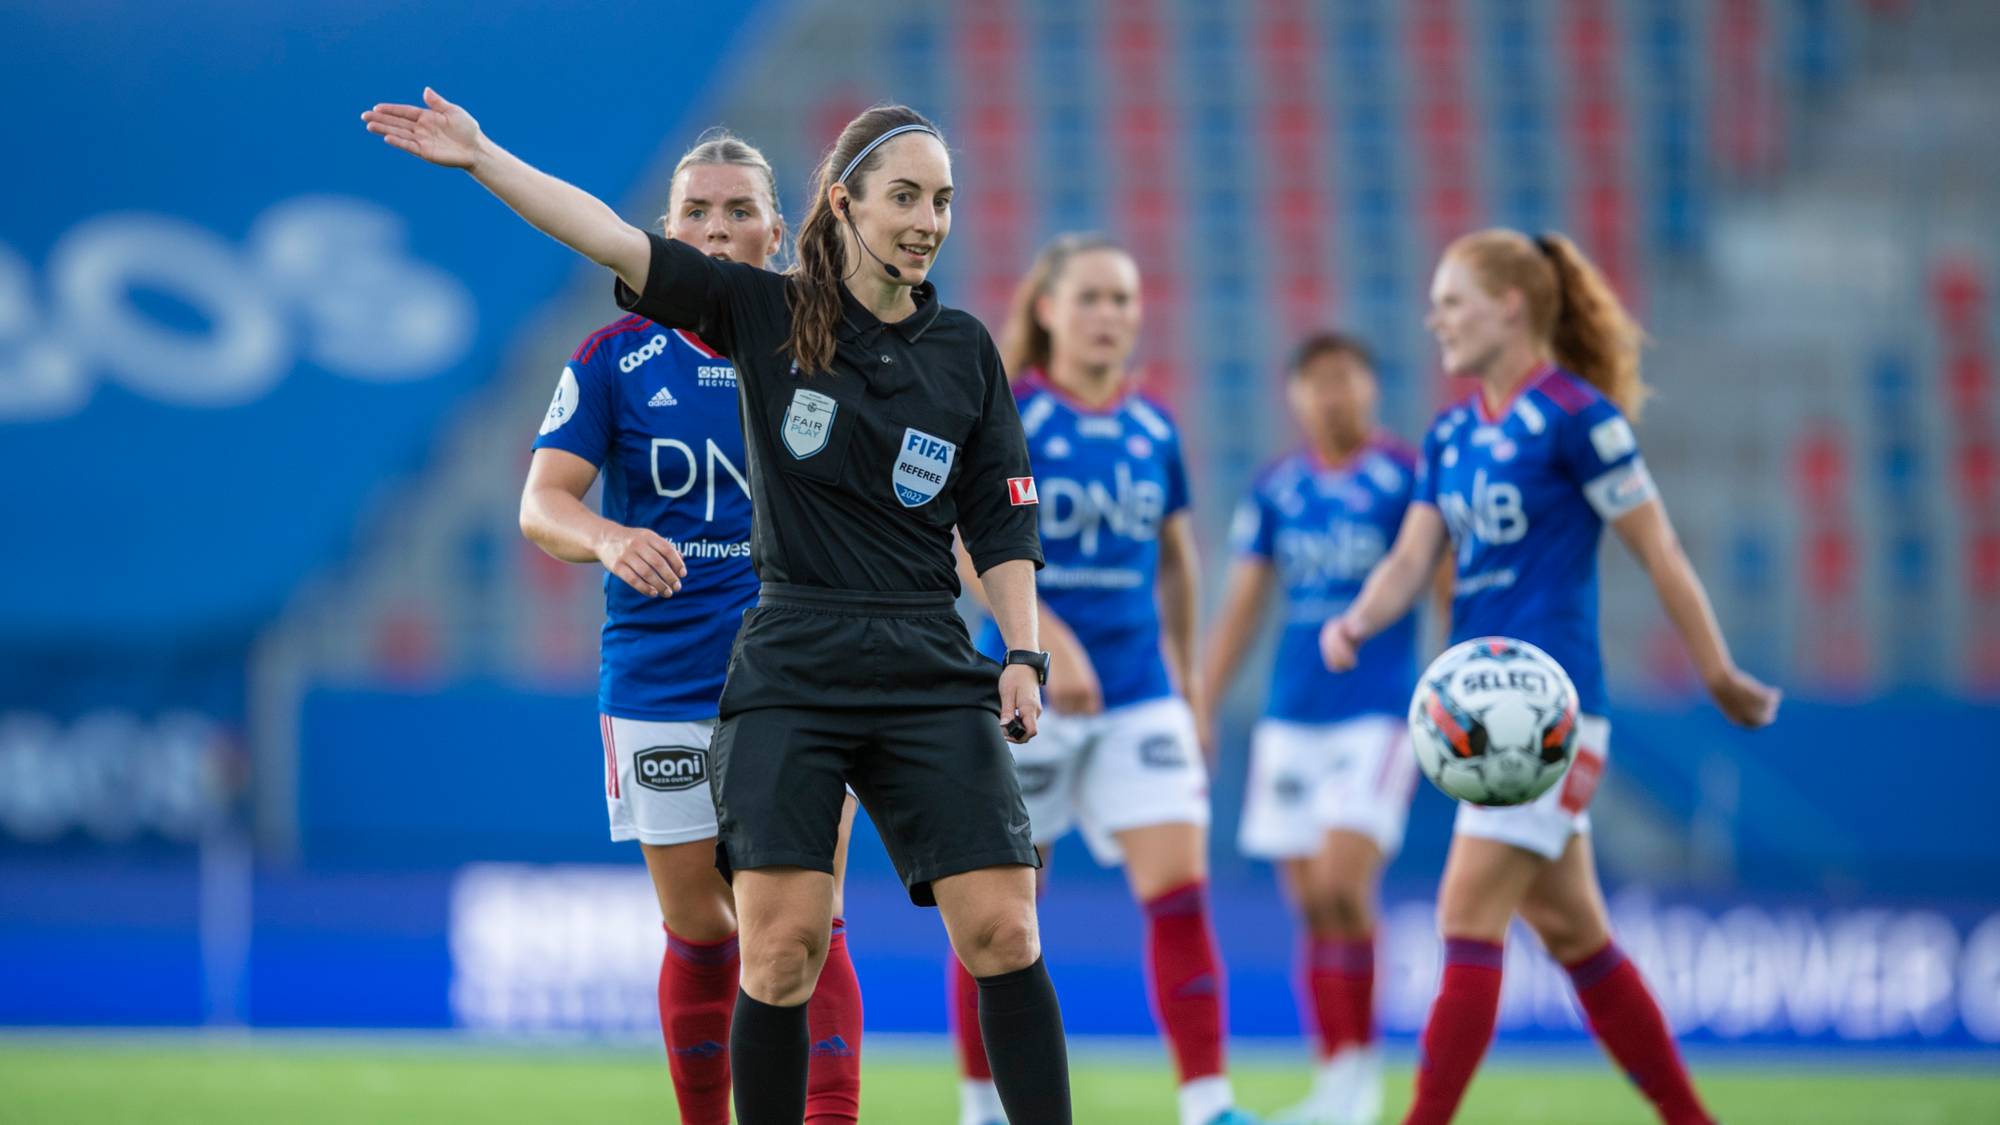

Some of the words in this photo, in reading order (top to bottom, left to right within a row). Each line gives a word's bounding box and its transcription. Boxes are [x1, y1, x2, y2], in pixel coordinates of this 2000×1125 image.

[619, 334, 667, 373] coop
[698, 379, 737, 388] RECYCL
[710, 366, 737, 379] STE
[648, 399, 677, 407] adidas
[791, 424, 820, 438] PLAY
[792, 415, 823, 431] FAIR
[907, 434, 948, 465] FIFA
[651, 437, 751, 522] DN
[899, 462, 942, 485] REFEREE
[901, 488, 922, 502] 2022
[1040, 461, 1166, 556] DNB
[1463, 671, 1546, 695] SELECT
[643, 755, 700, 777] ooni
